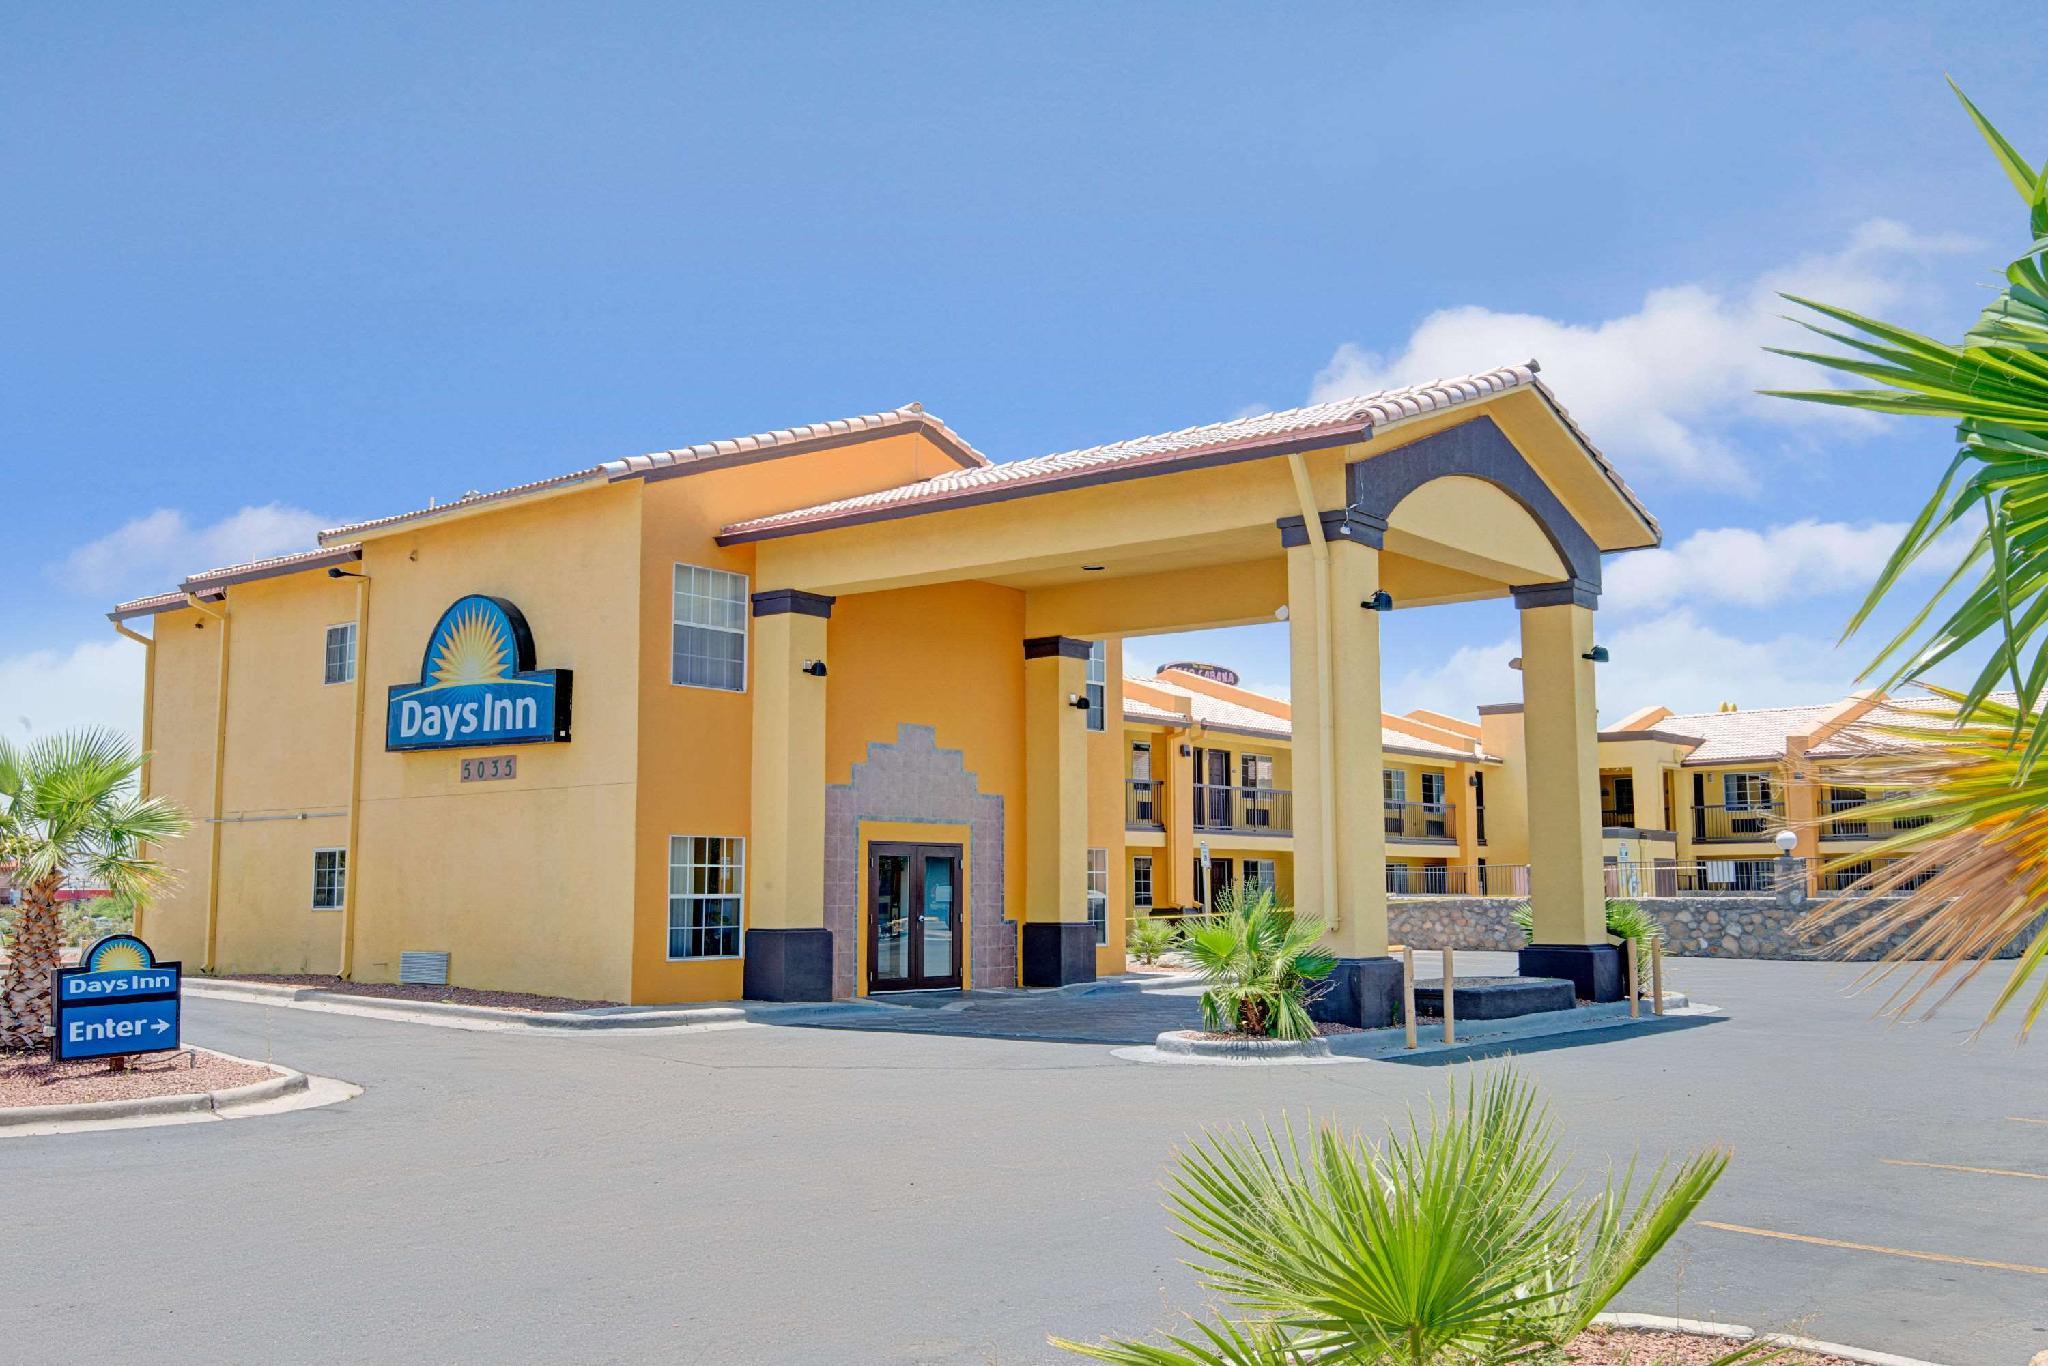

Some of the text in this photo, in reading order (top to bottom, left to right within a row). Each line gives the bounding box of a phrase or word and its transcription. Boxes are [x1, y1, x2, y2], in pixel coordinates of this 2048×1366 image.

[400, 693, 537, 741] Days Inn
[463, 758, 513, 780] 5035
[69, 975, 170, 994] Days Inn
[69, 1018, 148, 1042] Enter
